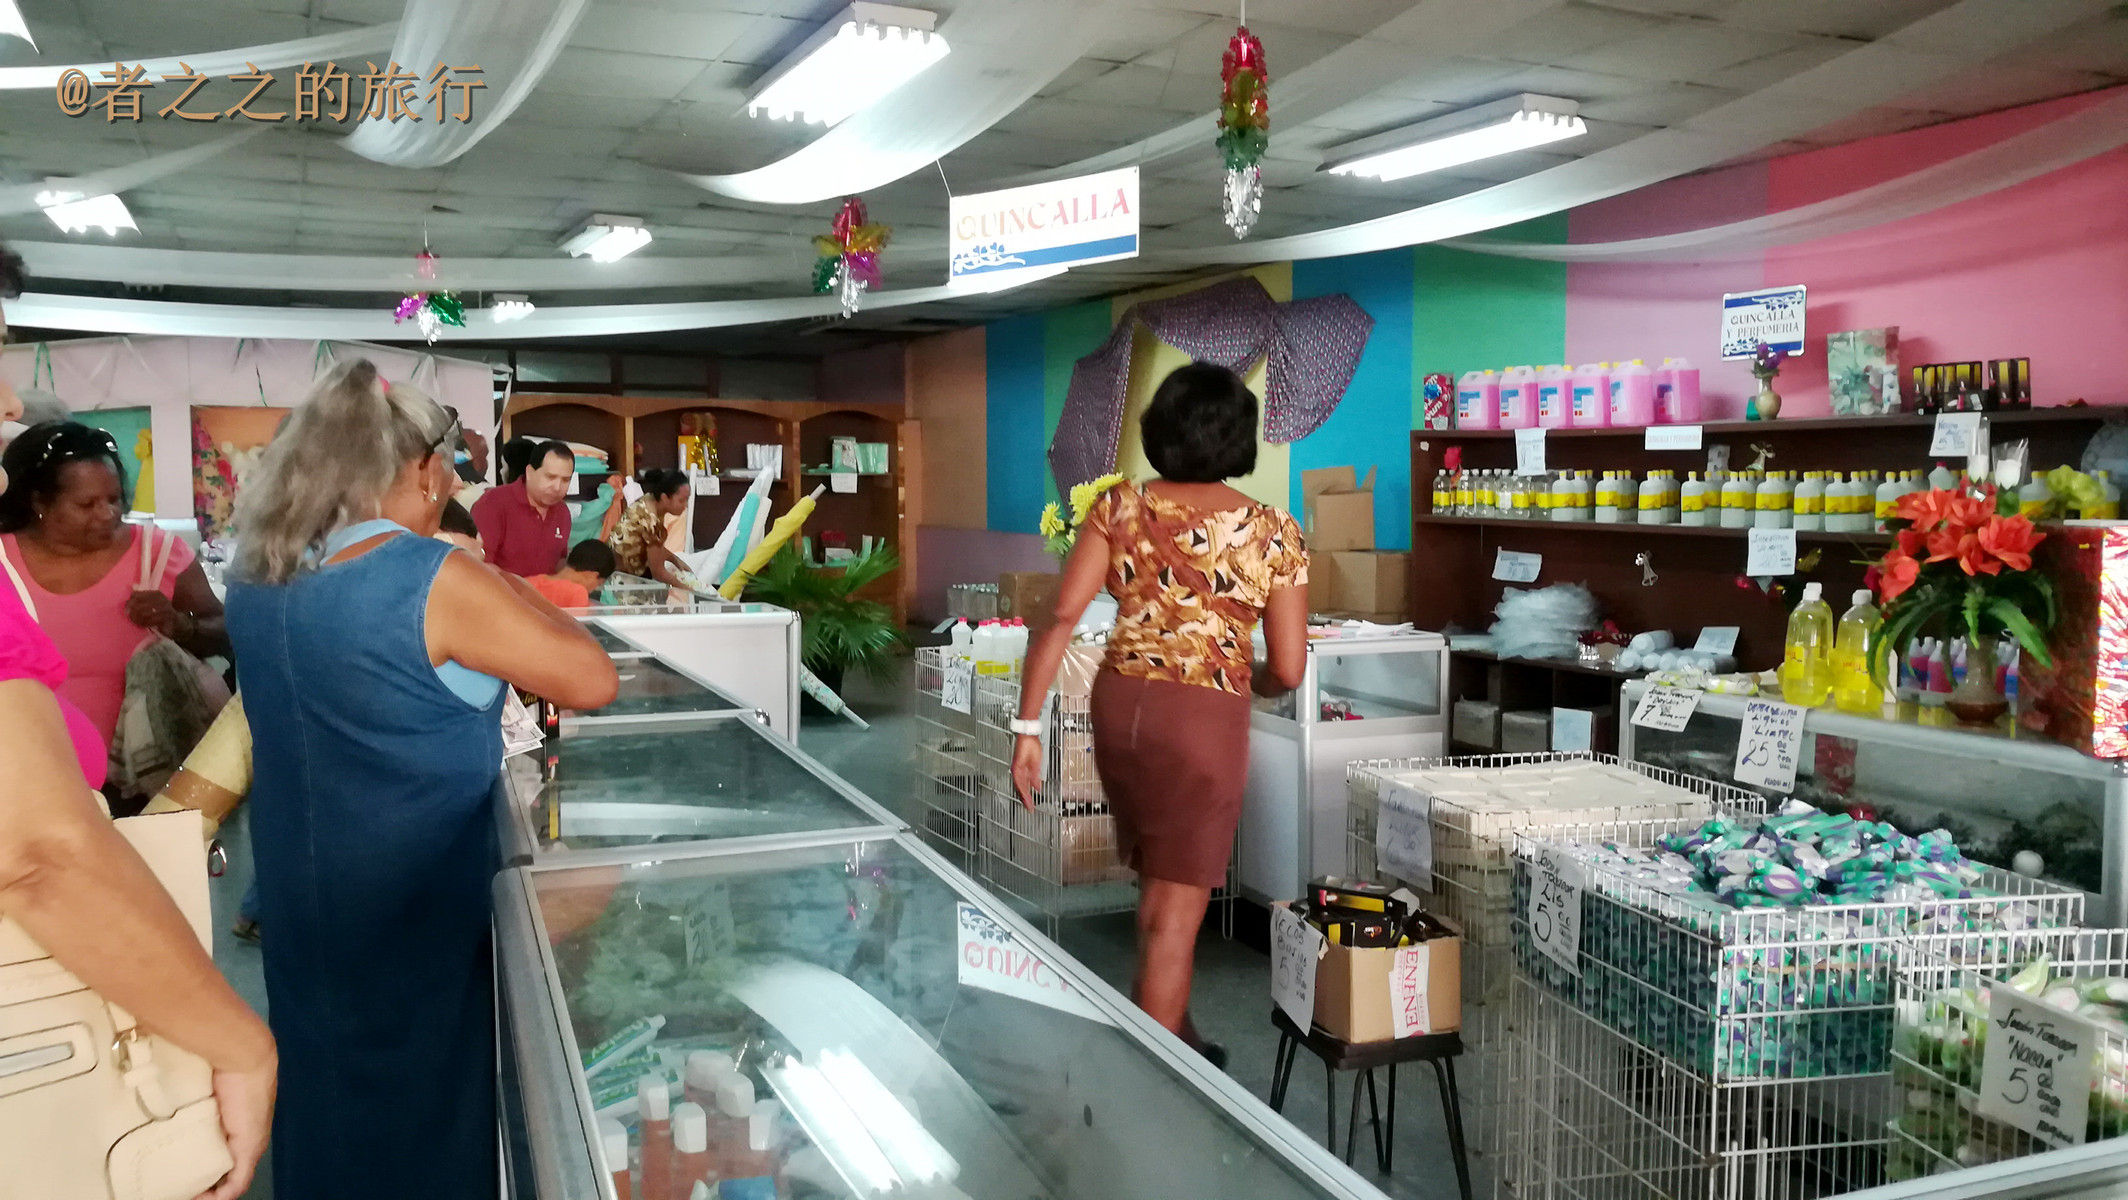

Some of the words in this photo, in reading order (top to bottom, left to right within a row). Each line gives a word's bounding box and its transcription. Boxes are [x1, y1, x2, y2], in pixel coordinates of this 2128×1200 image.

[956, 188, 1130, 241] QUINCALLA
[1727, 329, 1733, 338] Y
[1738, 322, 1799, 338] PERFUMERIA
[1731, 310, 1795, 325] QUINCALLA
[1742, 739, 1769, 767] 25
[1534, 902, 1552, 943] 5
[1278, 956, 1290, 990] 5
[2002, 1067, 2029, 1104] 5
